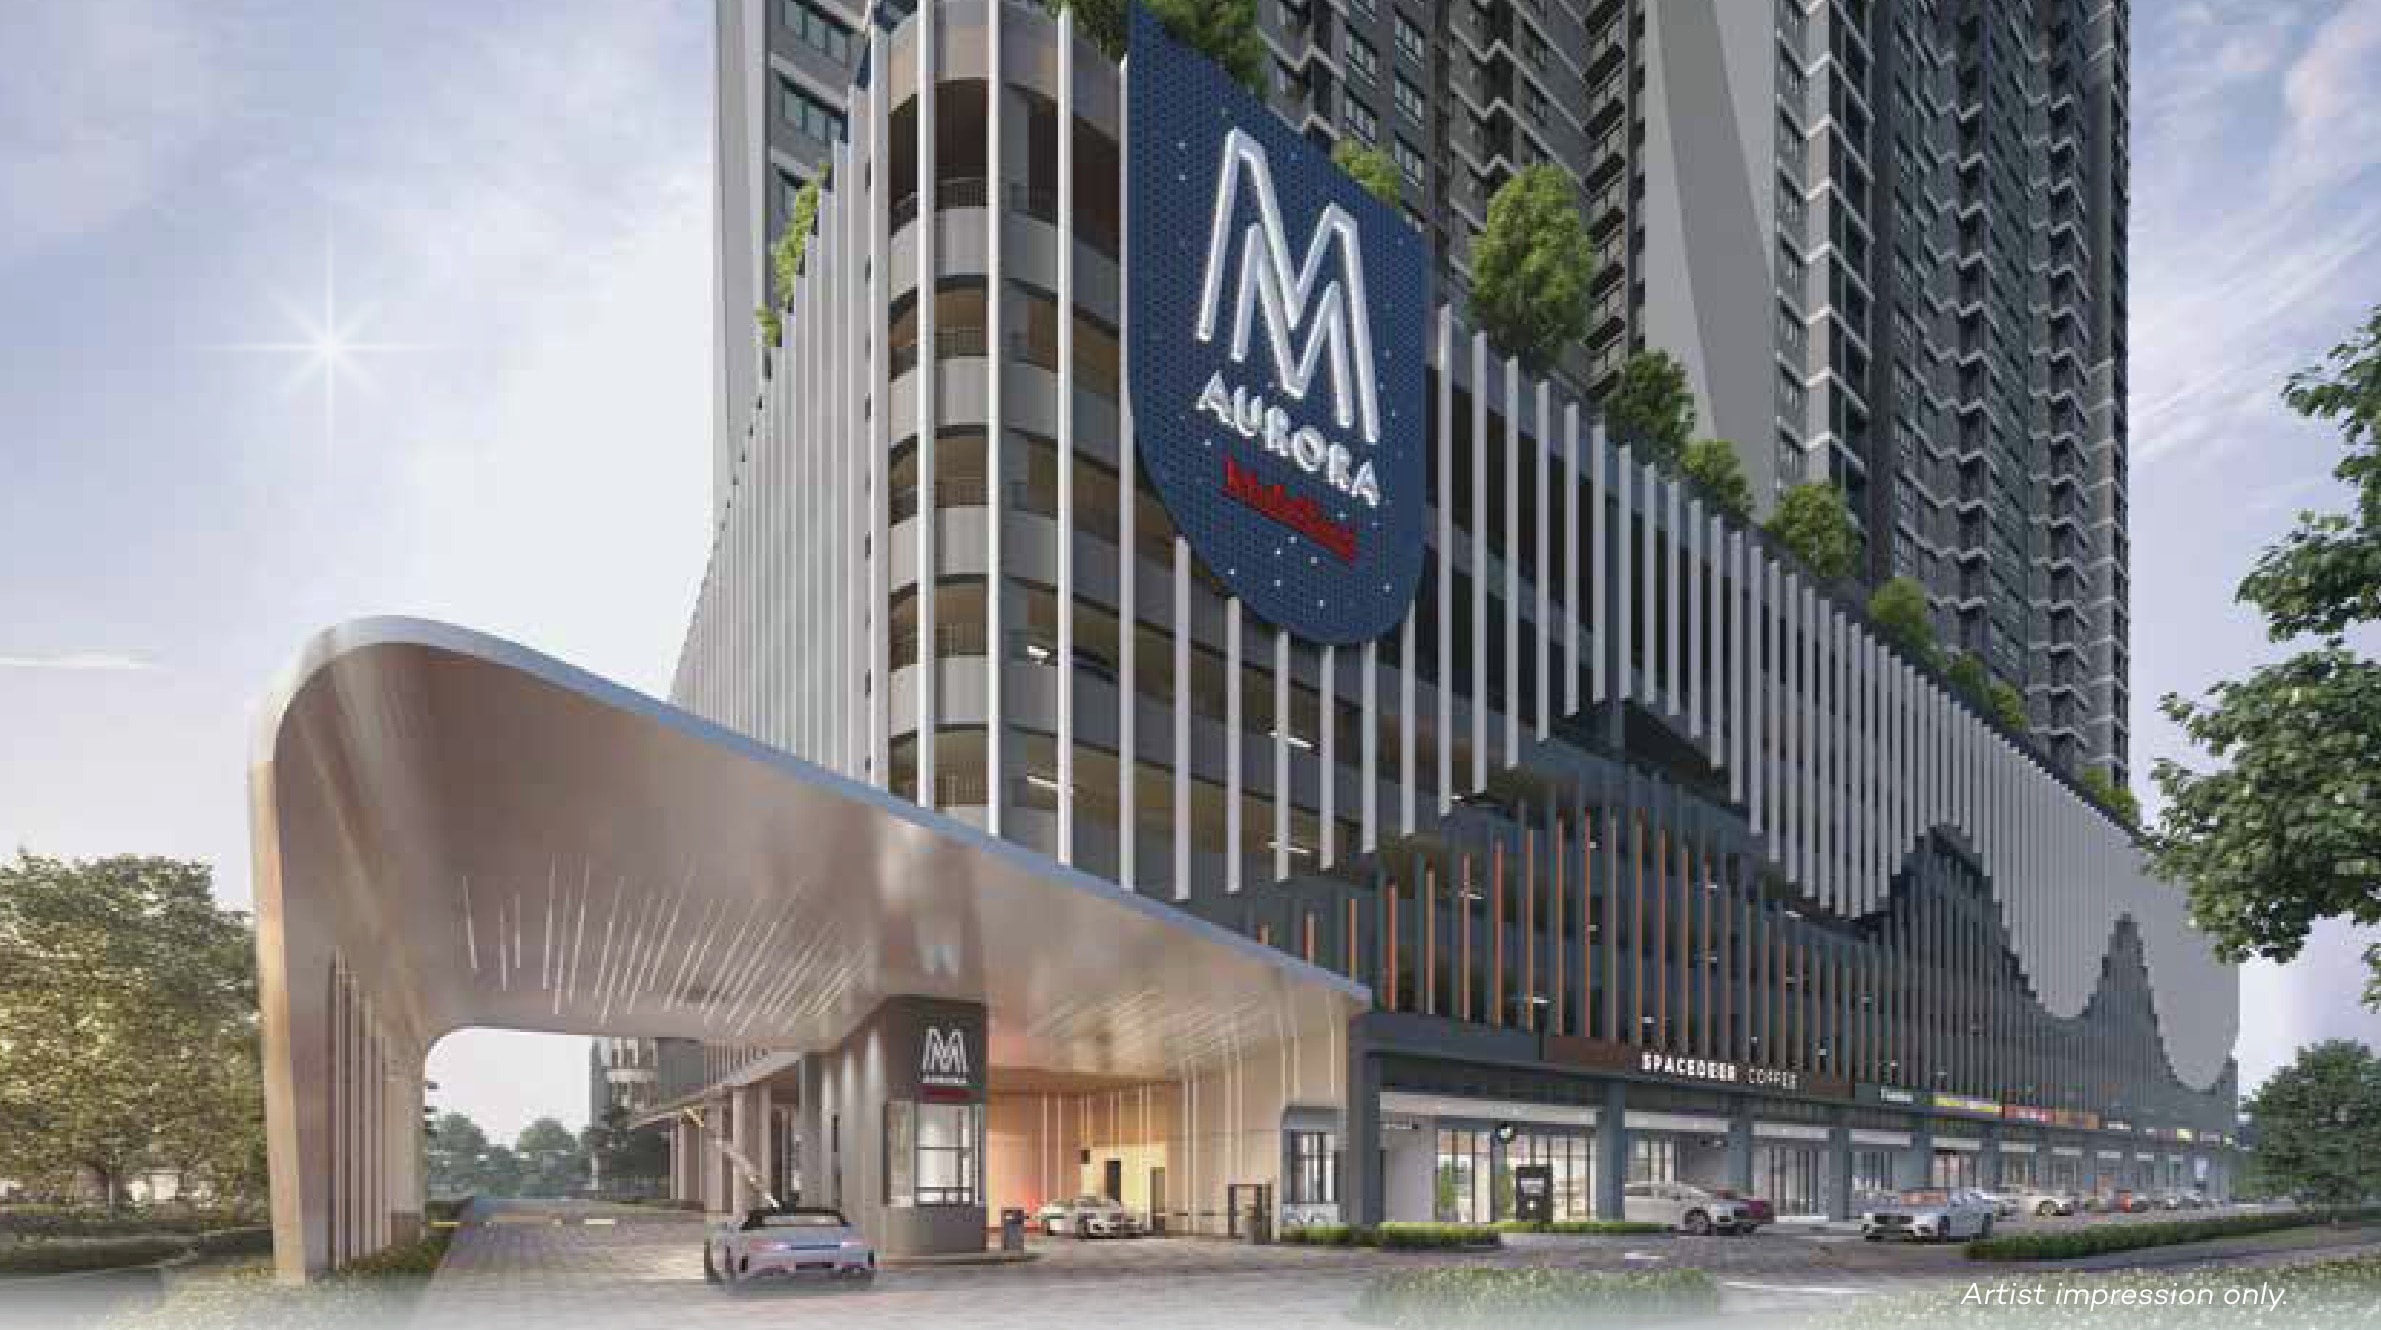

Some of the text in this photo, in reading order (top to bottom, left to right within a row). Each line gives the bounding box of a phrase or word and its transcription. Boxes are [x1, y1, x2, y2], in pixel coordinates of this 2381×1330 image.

[1195, 125, 1381, 445] M
[1195, 370, 1381, 508] AURORA
[1641, 1051, 1737, 1082] SPACEDEER
